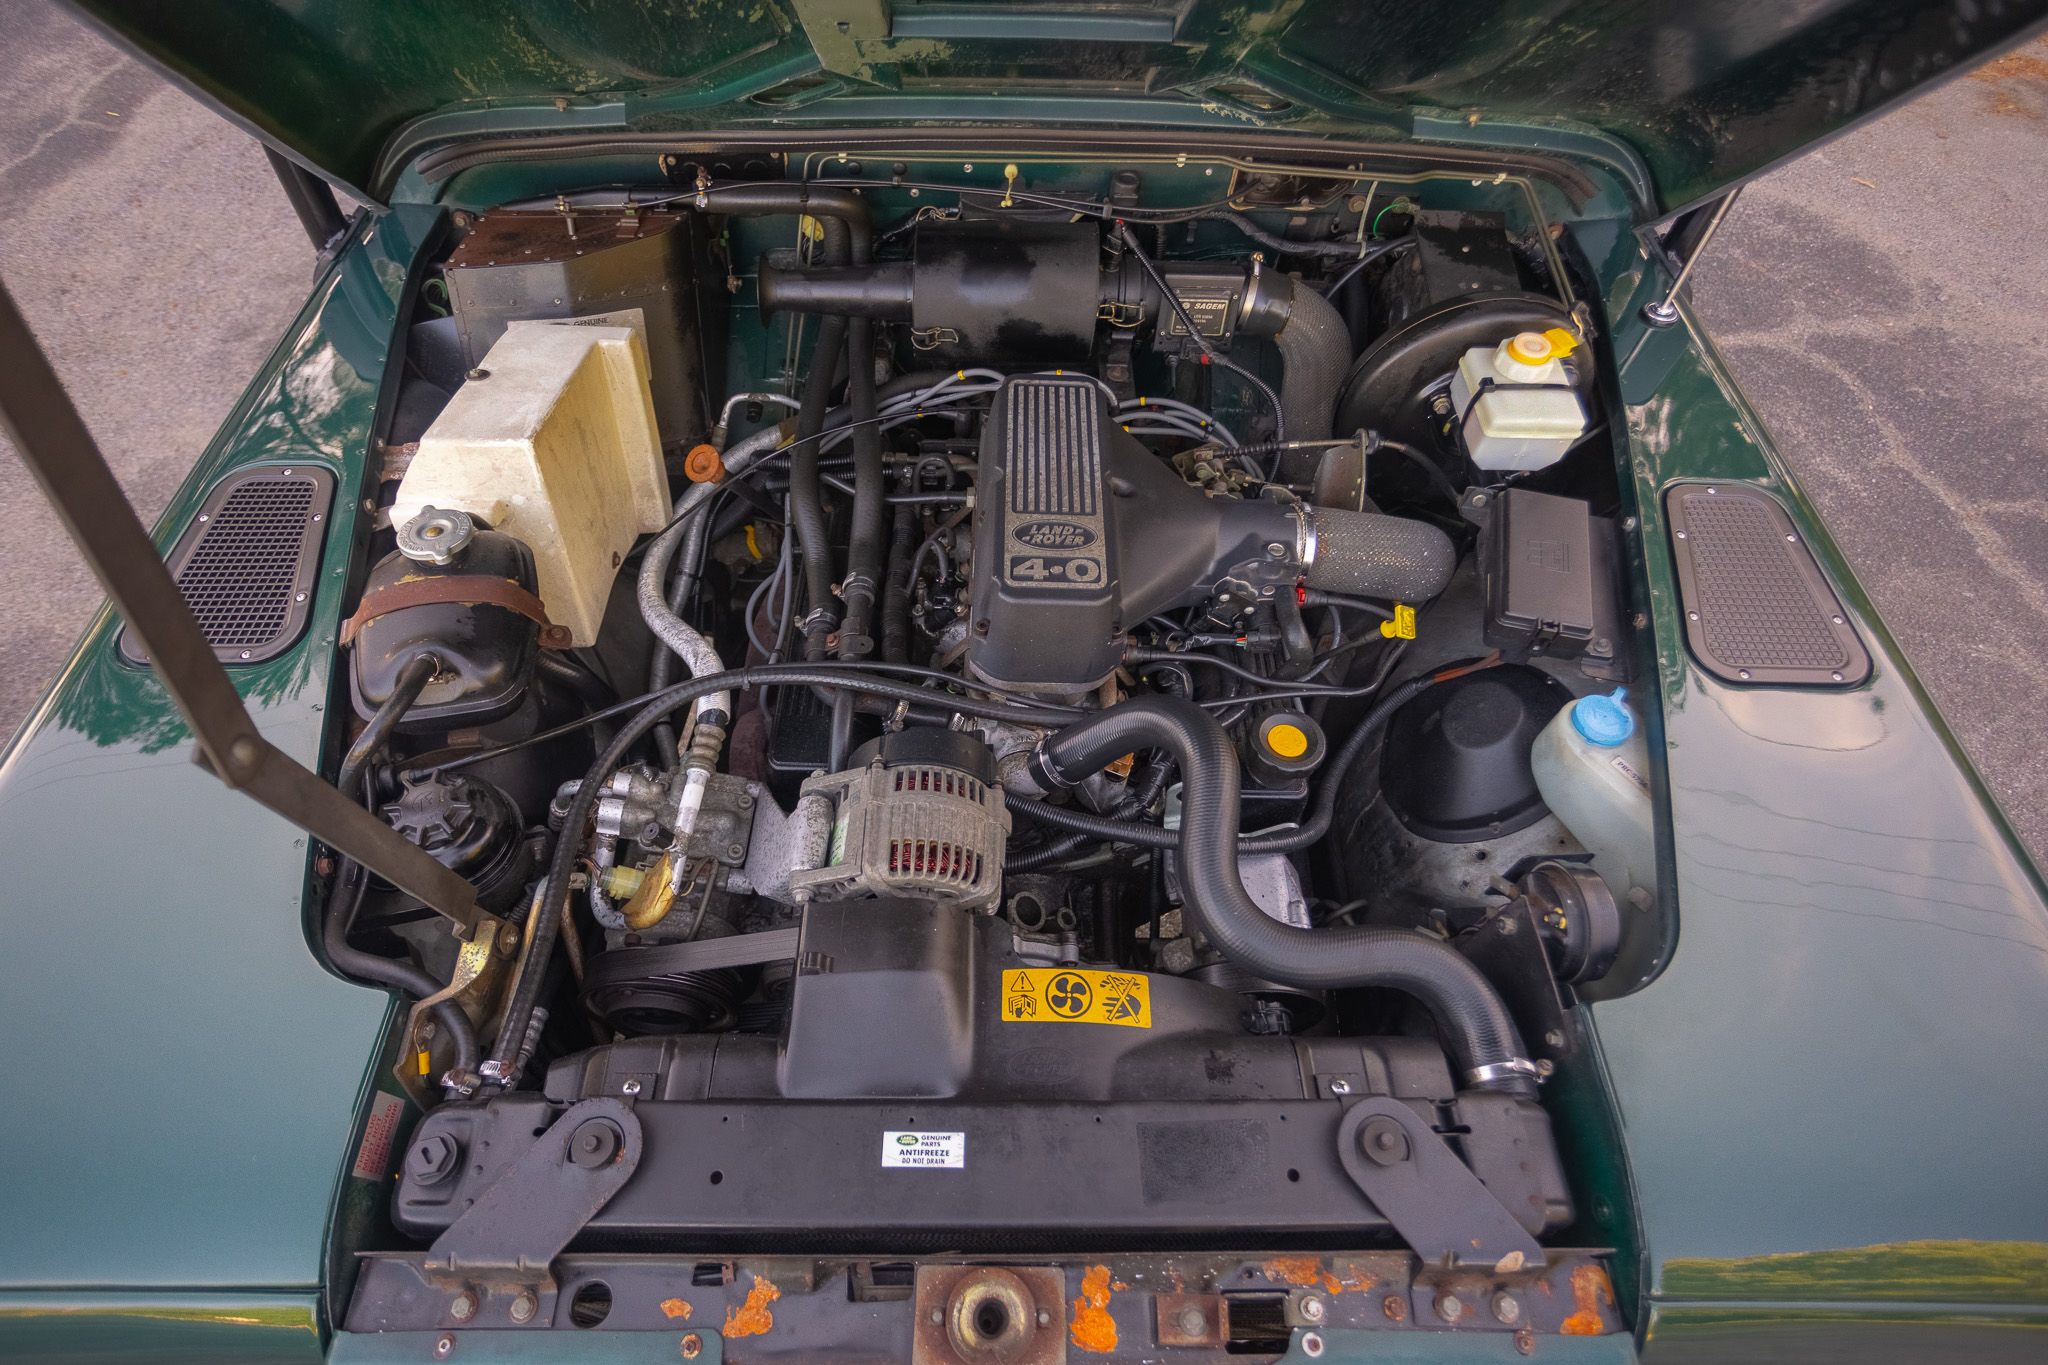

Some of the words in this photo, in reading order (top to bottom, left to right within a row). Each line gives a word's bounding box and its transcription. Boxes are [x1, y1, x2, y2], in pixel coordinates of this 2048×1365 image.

[573, 317, 609, 326] GENUINE
[1030, 524, 1076, 535] LAND
[1031, 534, 1085, 545] ROVER
[899, 1149, 950, 1157] ANTIFREEZE
[913, 1157, 925, 1165] NOT
